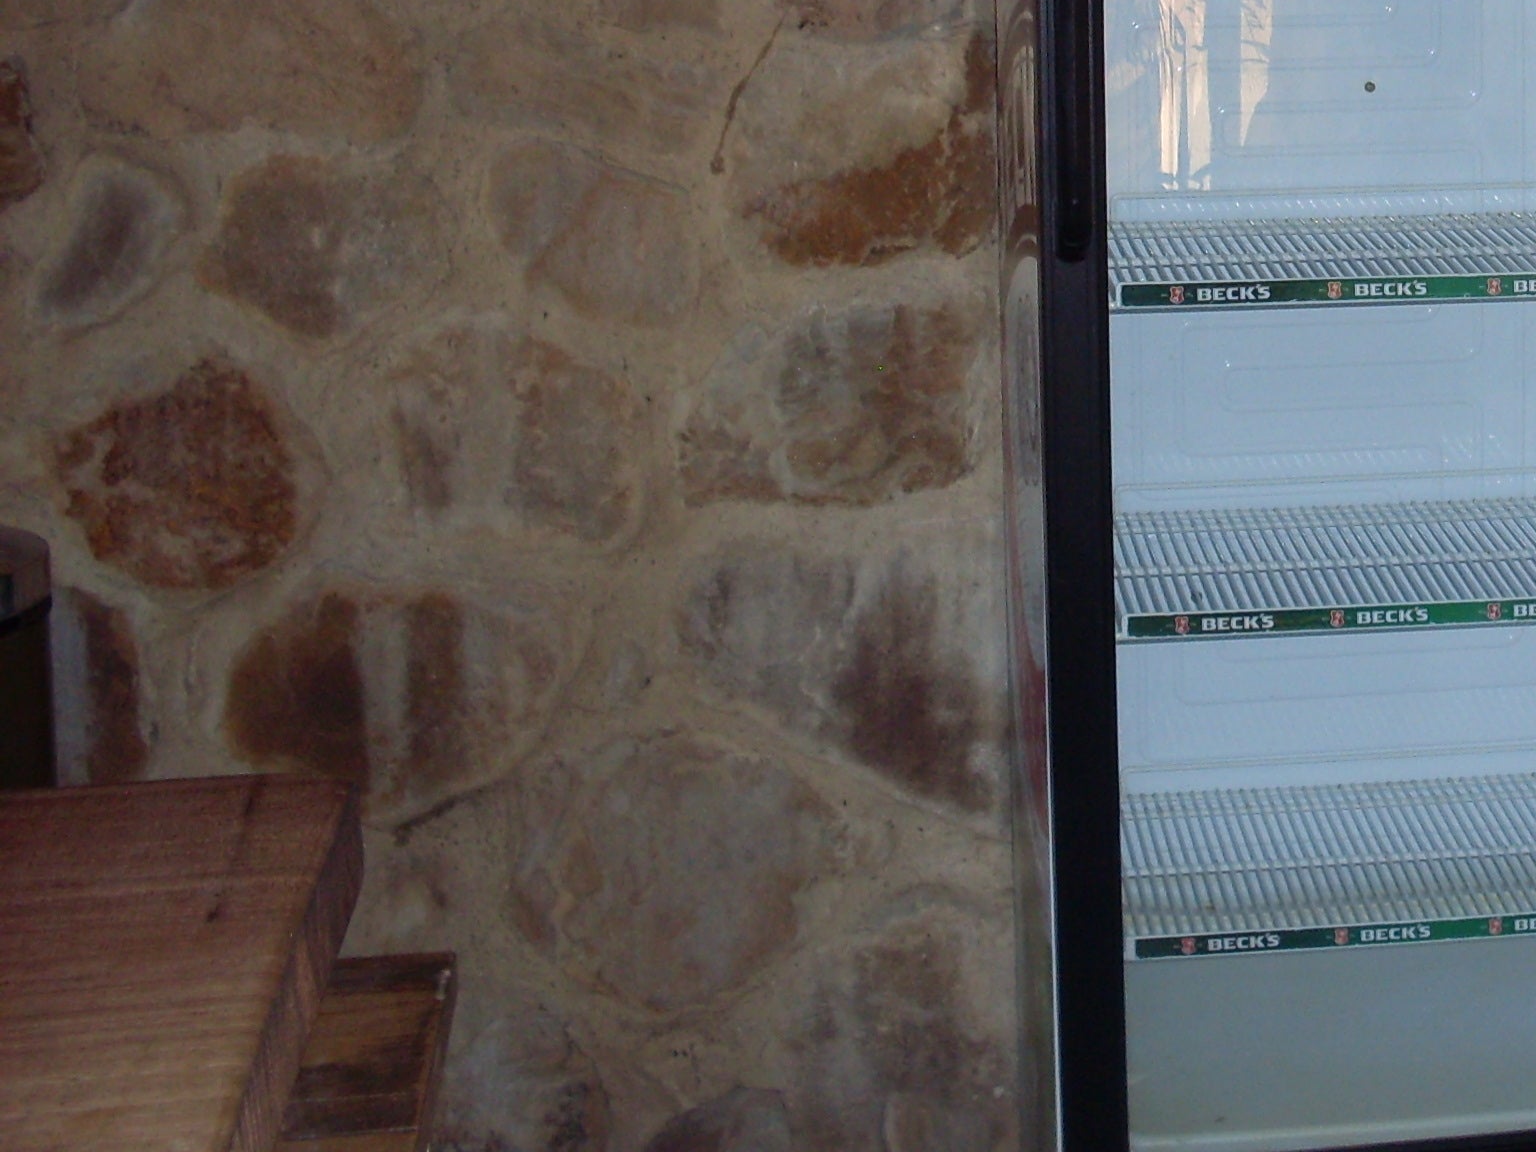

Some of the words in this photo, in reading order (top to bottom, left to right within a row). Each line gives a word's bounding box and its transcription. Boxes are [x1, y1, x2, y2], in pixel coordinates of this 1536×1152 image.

[1196, 283, 1271, 301] BECK'S
[1354, 279, 1428, 297] BECK'S
[1201, 613, 1275, 632] BECK'S
[1356, 606, 1429, 625] BECK'S
[1207, 933, 1281, 951] BECK'S
[1359, 923, 1432, 942] BECK'S
